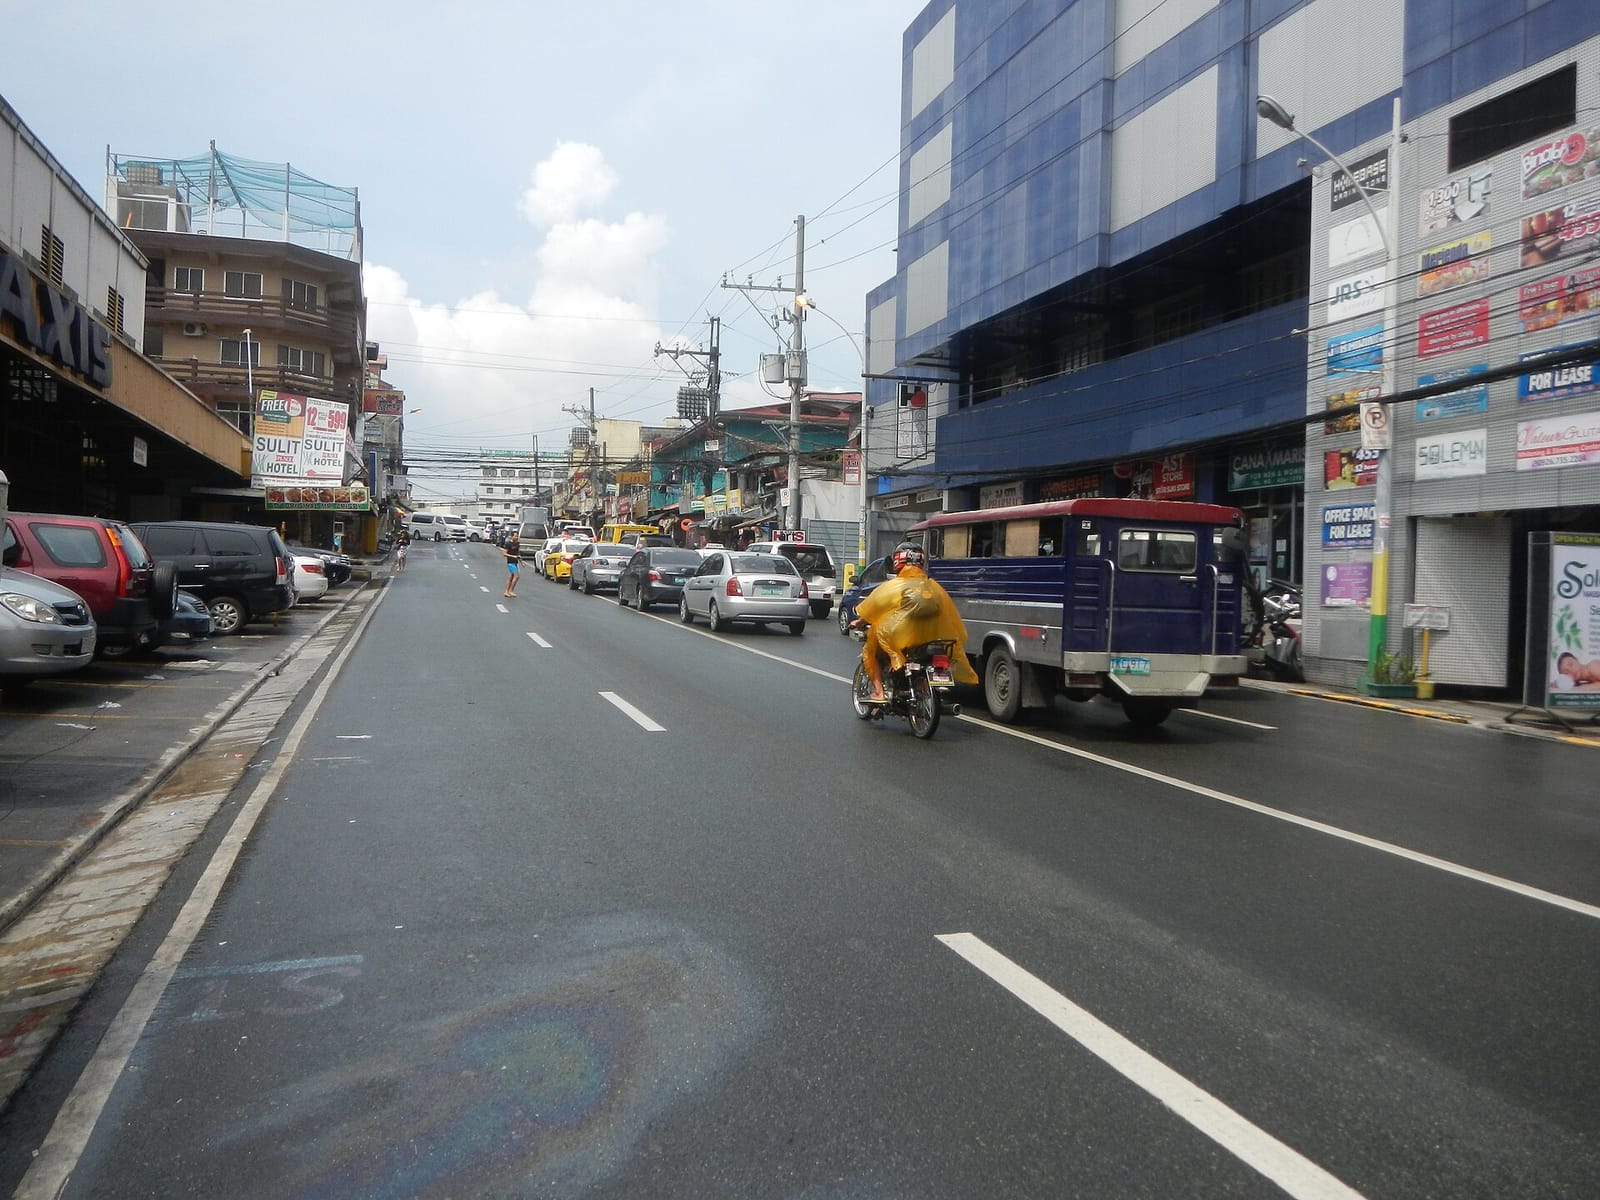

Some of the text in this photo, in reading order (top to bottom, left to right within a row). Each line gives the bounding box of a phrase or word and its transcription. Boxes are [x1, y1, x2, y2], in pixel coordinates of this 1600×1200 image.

[0, 247, 112, 388] AXIS
[1529, 365, 1593, 392] FOR LEASE
[261, 399, 285, 411] FREE
[328, 409, 347, 430] 599
[256, 437, 300, 455] SULIT
[304, 439, 344, 453] SULIT
[266, 462, 298, 475] HOTEL
[313, 457, 343, 468] HOTEL
[1324, 508, 1352, 523] OFFICE
[1330, 523, 1372, 539] FOR LEASE
